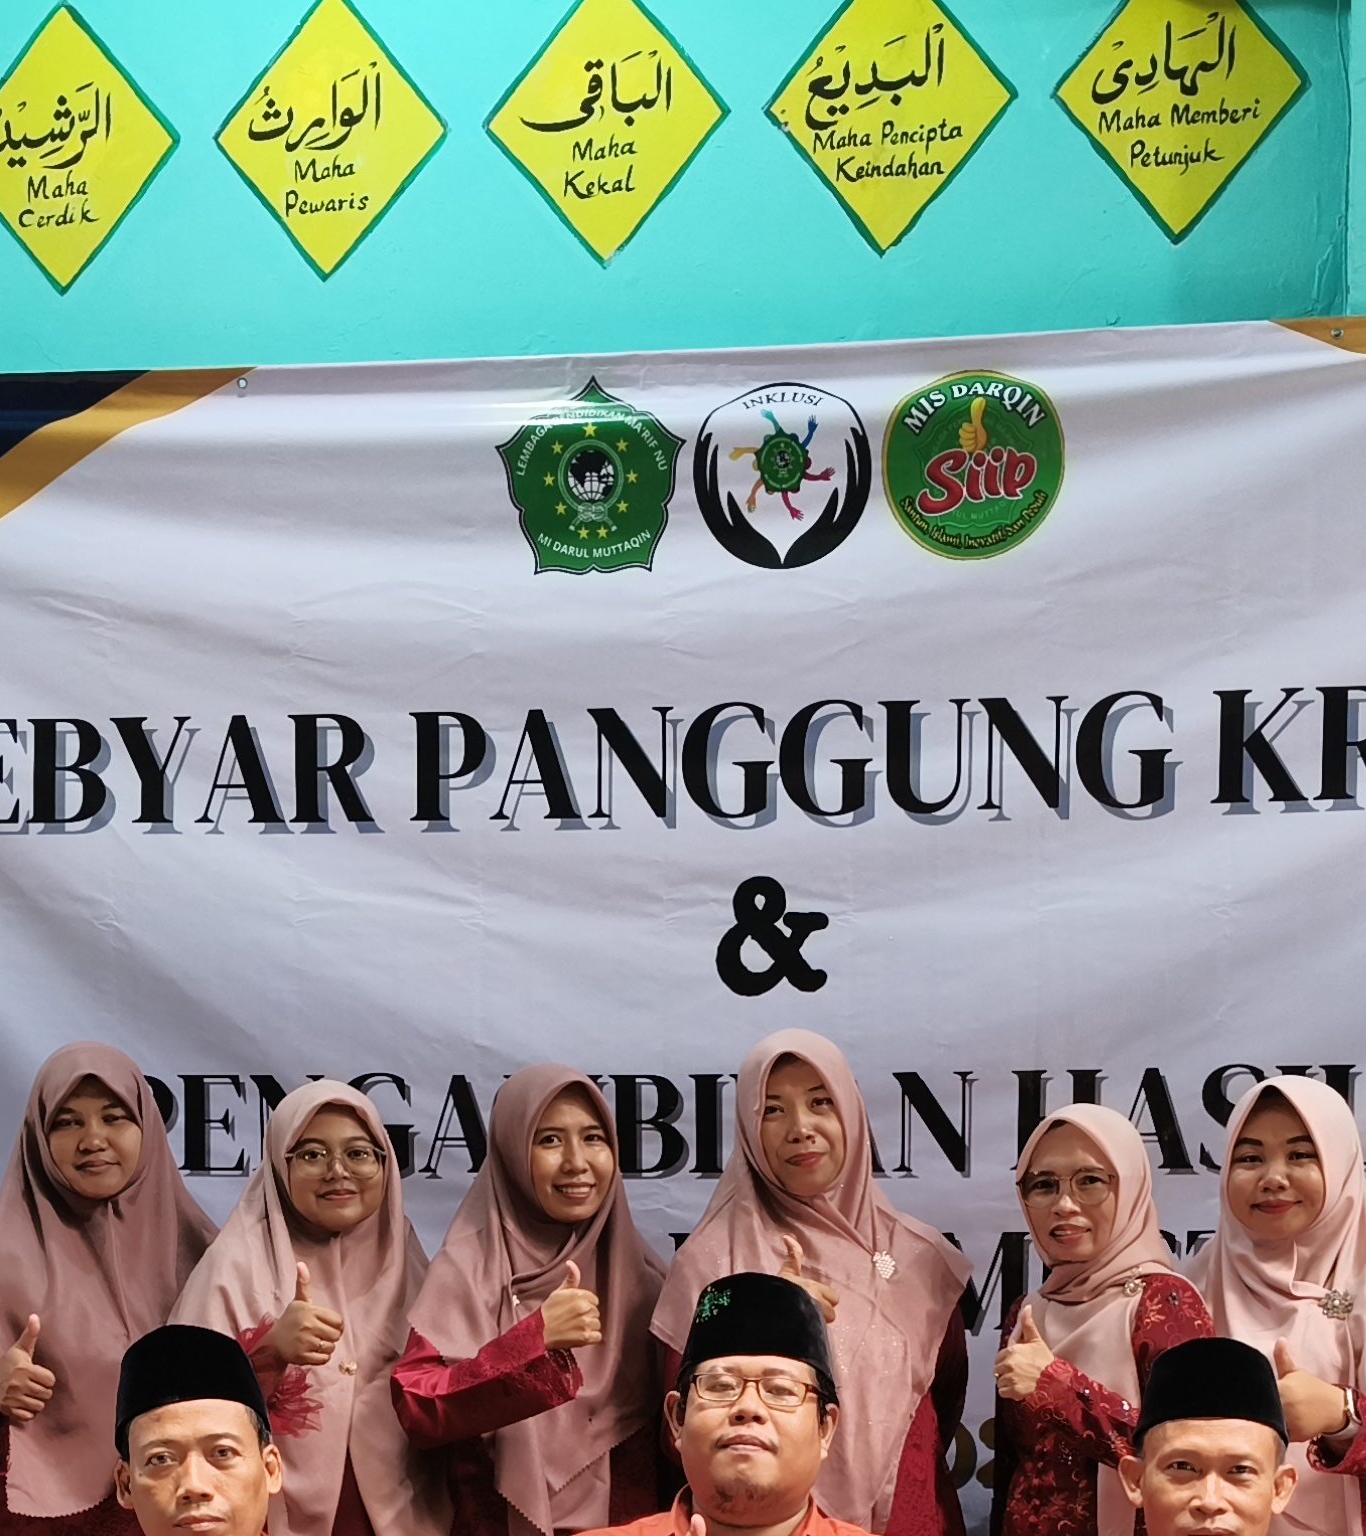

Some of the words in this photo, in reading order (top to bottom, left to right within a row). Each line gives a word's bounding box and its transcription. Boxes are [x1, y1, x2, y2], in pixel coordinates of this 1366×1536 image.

[1099, 106, 1161, 135] Maha
[1171, 97, 1261, 128] Memberi
[572, 133, 639, 162] Maha
[813, 126, 872, 154] Maha
[881, 118, 963, 155] Pencipta
[294, 154, 356, 183] Maha
[836, 151, 945, 182] Keindahan
[1130, 137, 1225, 176] Petunjuk
[28, 170, 89, 204] Maha
[563, 164, 636, 199] Kekal
[18, 199, 101, 228] Cerdik
[285, 189, 370, 217] Pewaris
[742, 392, 825, 410] INKLUSI
[903, 391, 946, 434] MIS
[952, 382, 1046, 428] DARQIN
[653, 450, 668, 471] NU
[916, 446, 1037, 517] Siip
[537, 533, 552, 547] MI
[552, 540, 590, 558] DARUL
[592, 529, 652, 558] MUTTAQIN
[409, 690, 1182, 832] PANGGUNG
[716, 876, 829, 998] &
